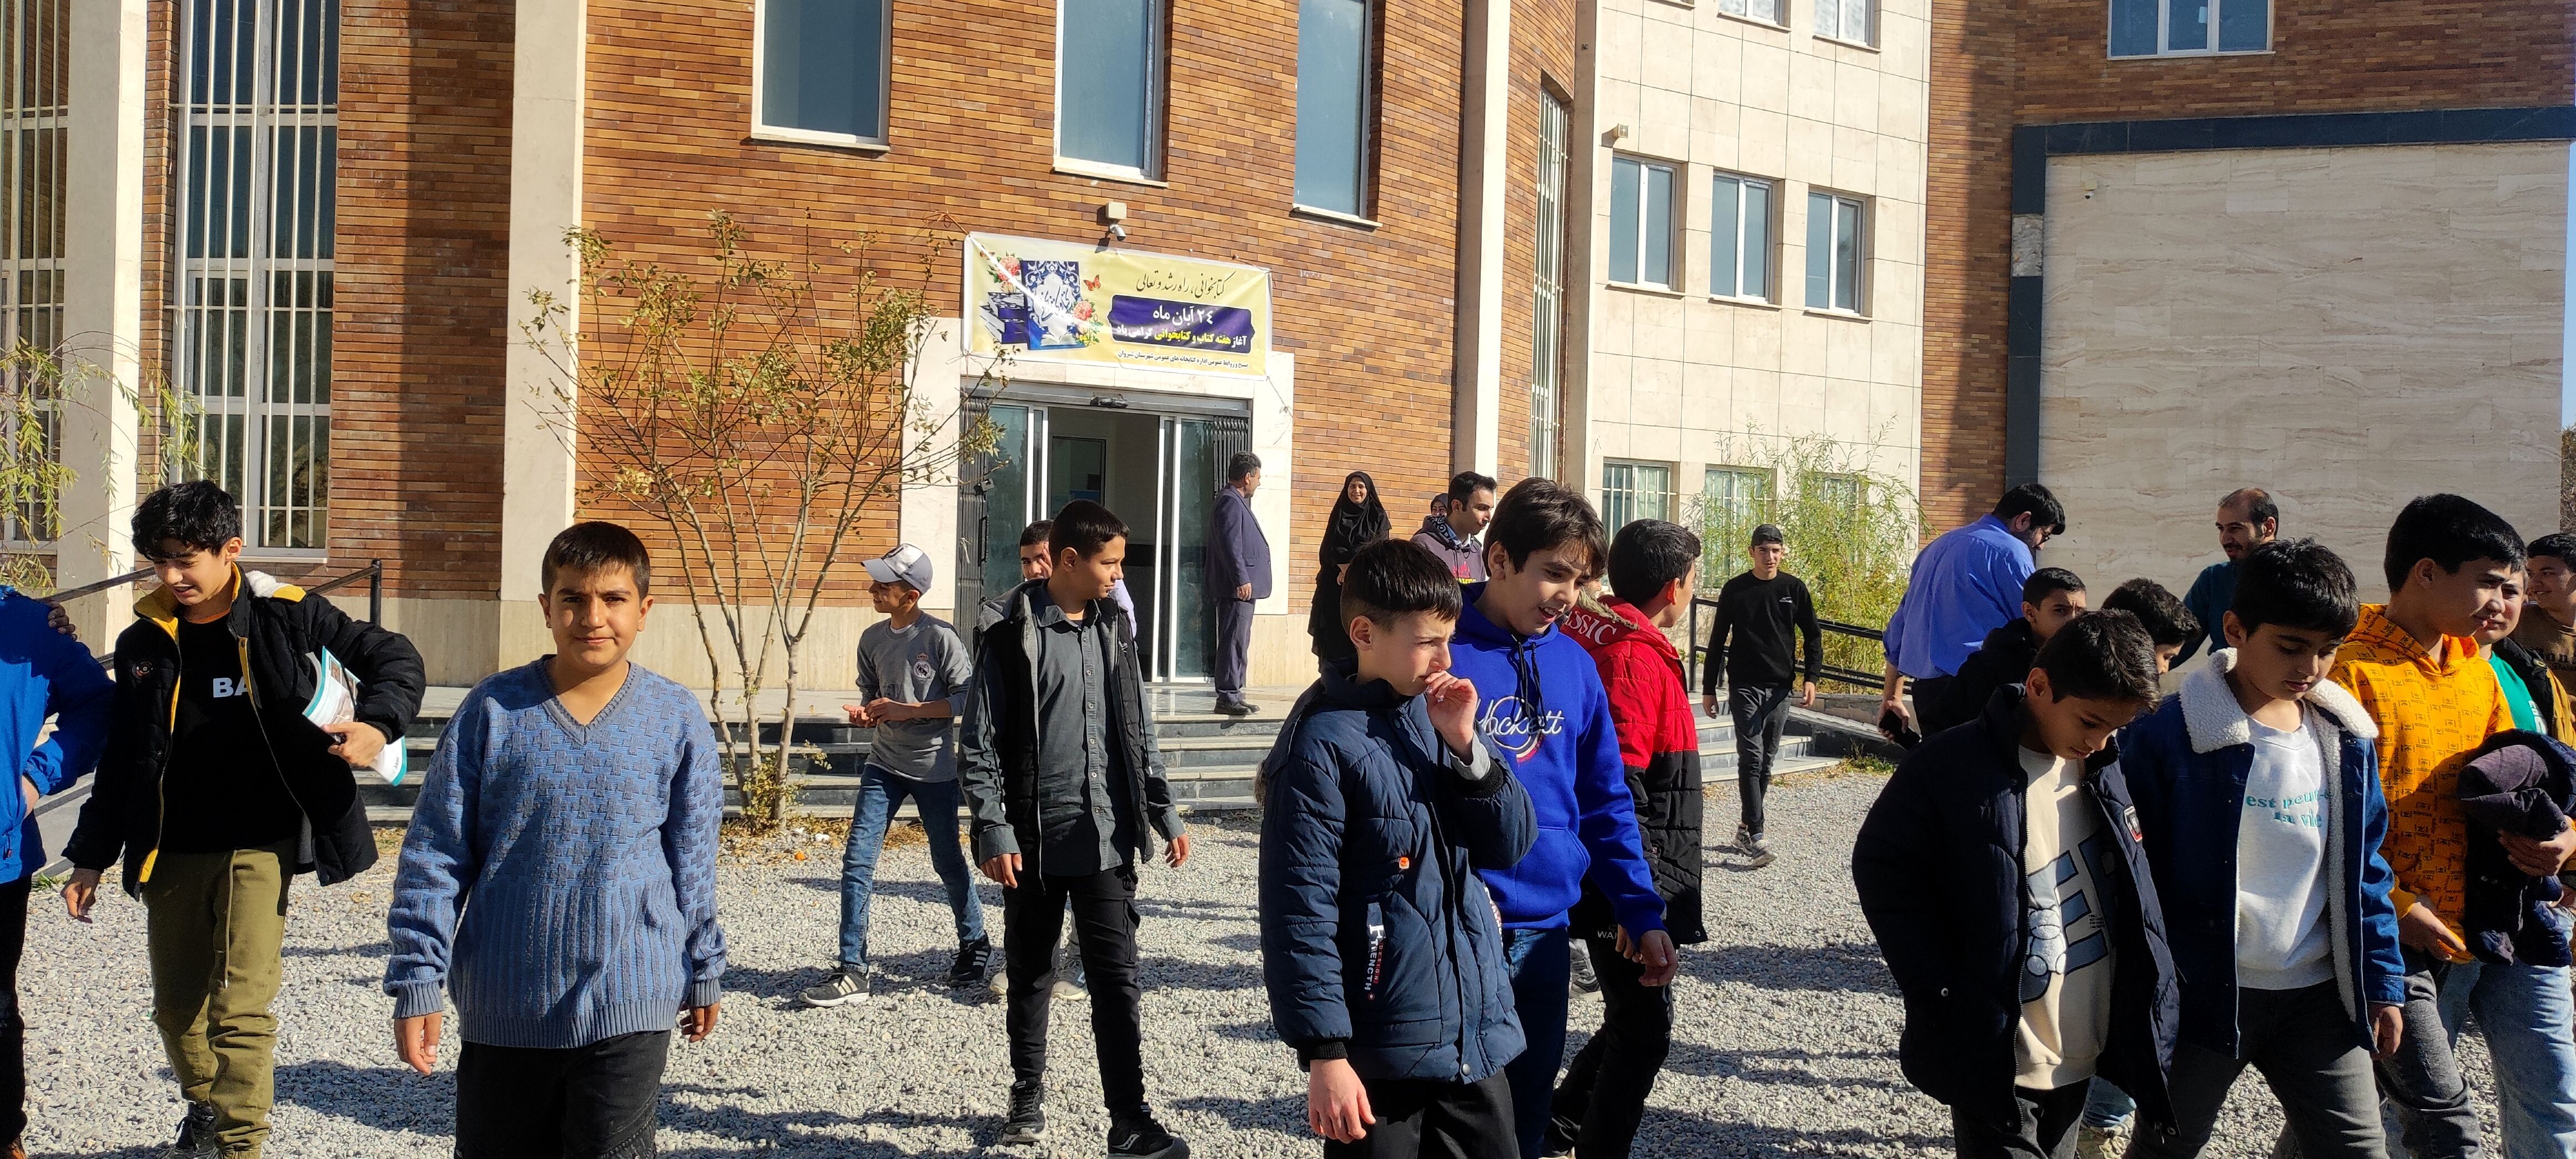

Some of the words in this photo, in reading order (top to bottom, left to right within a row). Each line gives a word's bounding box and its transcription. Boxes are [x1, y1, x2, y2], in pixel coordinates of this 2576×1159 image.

[1153, 305, 1170, 320] ماه
[1171, 306, 1195, 326] آبان
[1154, 328, 1191, 342] کتابخوانی
[1191, 335, 1196, 344] و
[1197, 333, 1214, 343] کتاب
[1215, 334, 1231, 345] هفته
[1231, 335, 1247, 348] آغاز
[2246, 795, 2276, 808] est
[2301, 809, 2323, 828] vie
